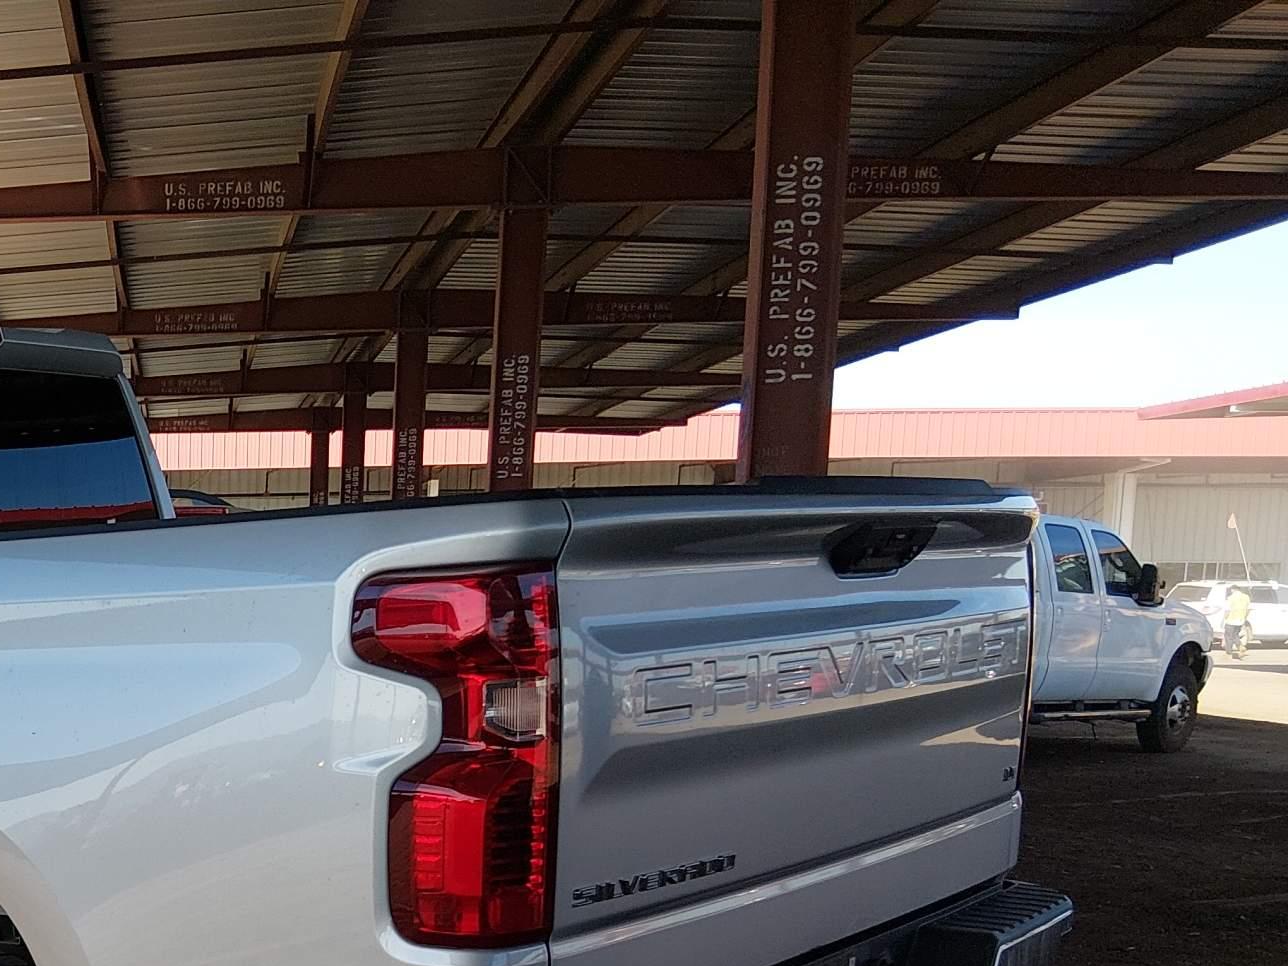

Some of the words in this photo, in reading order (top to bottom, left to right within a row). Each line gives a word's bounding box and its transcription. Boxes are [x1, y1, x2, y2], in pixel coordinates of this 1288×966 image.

[164, 182, 191, 197] U.S.
[198, 180, 253, 195] PREFAB
[258, 180, 286, 194] INC.
[774, 154, 799, 204] INC.
[850, 166, 908, 179] PREFAB
[914, 165, 942, 179] INC.
[165, 195, 285, 211] 1-866-799-0969
[768, 219, 795, 320] PREFAB
[791, 155, 824, 381] 1-866-799-0969
[501, 353, 517, 382] INC.
[764, 335, 789, 384] U.S.
[497, 388, 514, 445] PREFAB
[511, 354, 530, 478] 1-866-799-0969
[495, 452, 511, 480] U.S.
[631, 619, 1025, 727] CHEVROLET
[571, 854, 738, 909] SILVERADO
